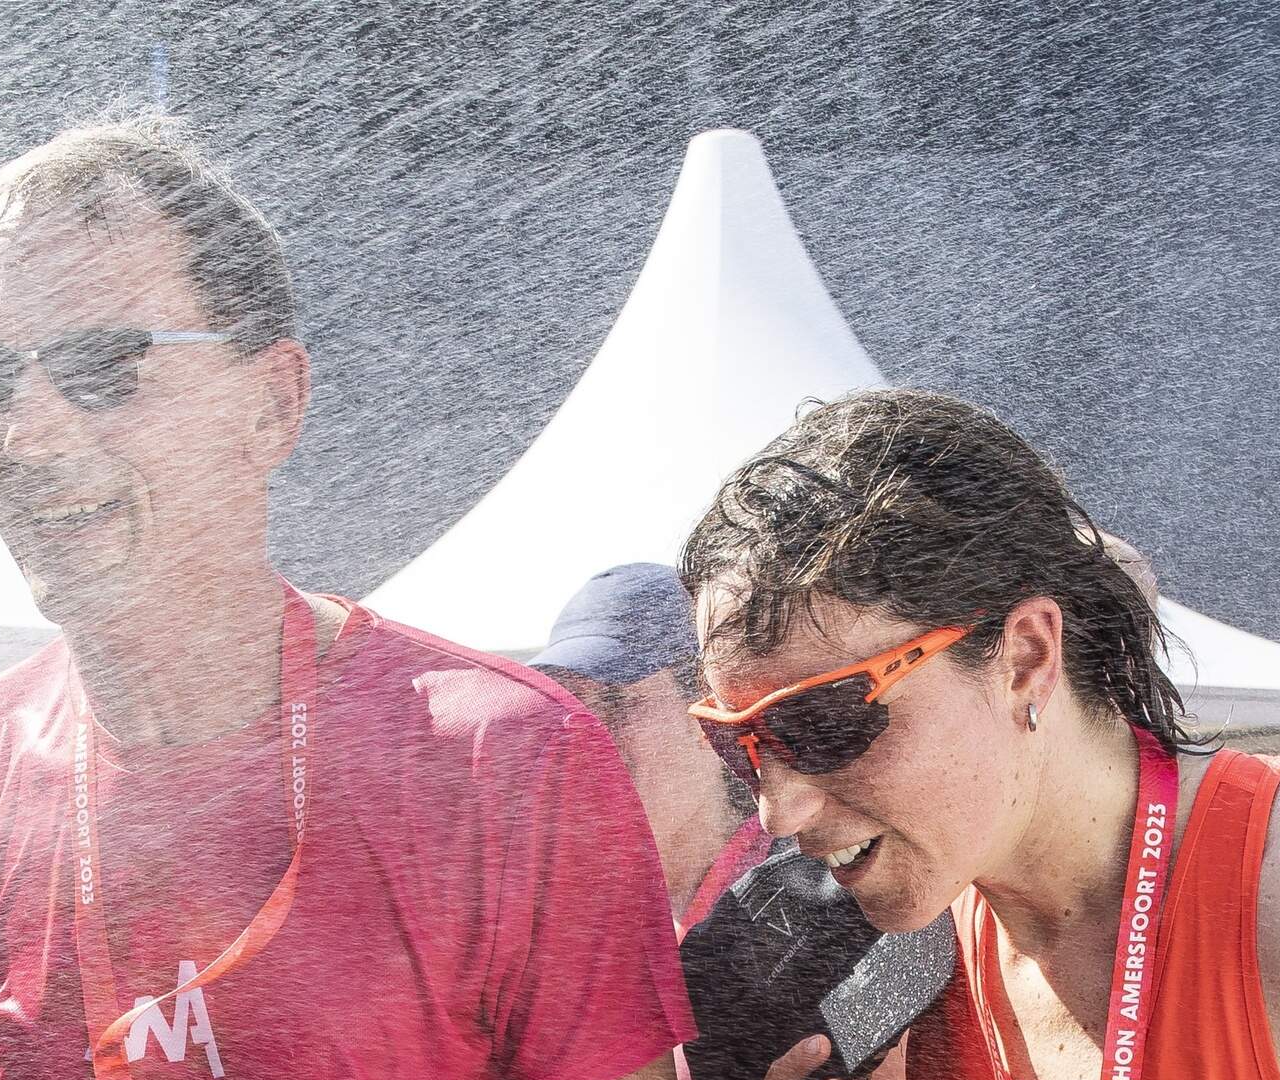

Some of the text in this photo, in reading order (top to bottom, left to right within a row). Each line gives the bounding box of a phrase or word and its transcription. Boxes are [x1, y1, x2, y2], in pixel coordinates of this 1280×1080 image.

[291, 703, 307, 748] 2023
[74, 723, 92, 848] AMERSFOORT
[80, 855, 95, 905] 2023
[1121, 866, 1158, 1021] AMERSFOORT
[1143, 803, 1167, 859] 2023
